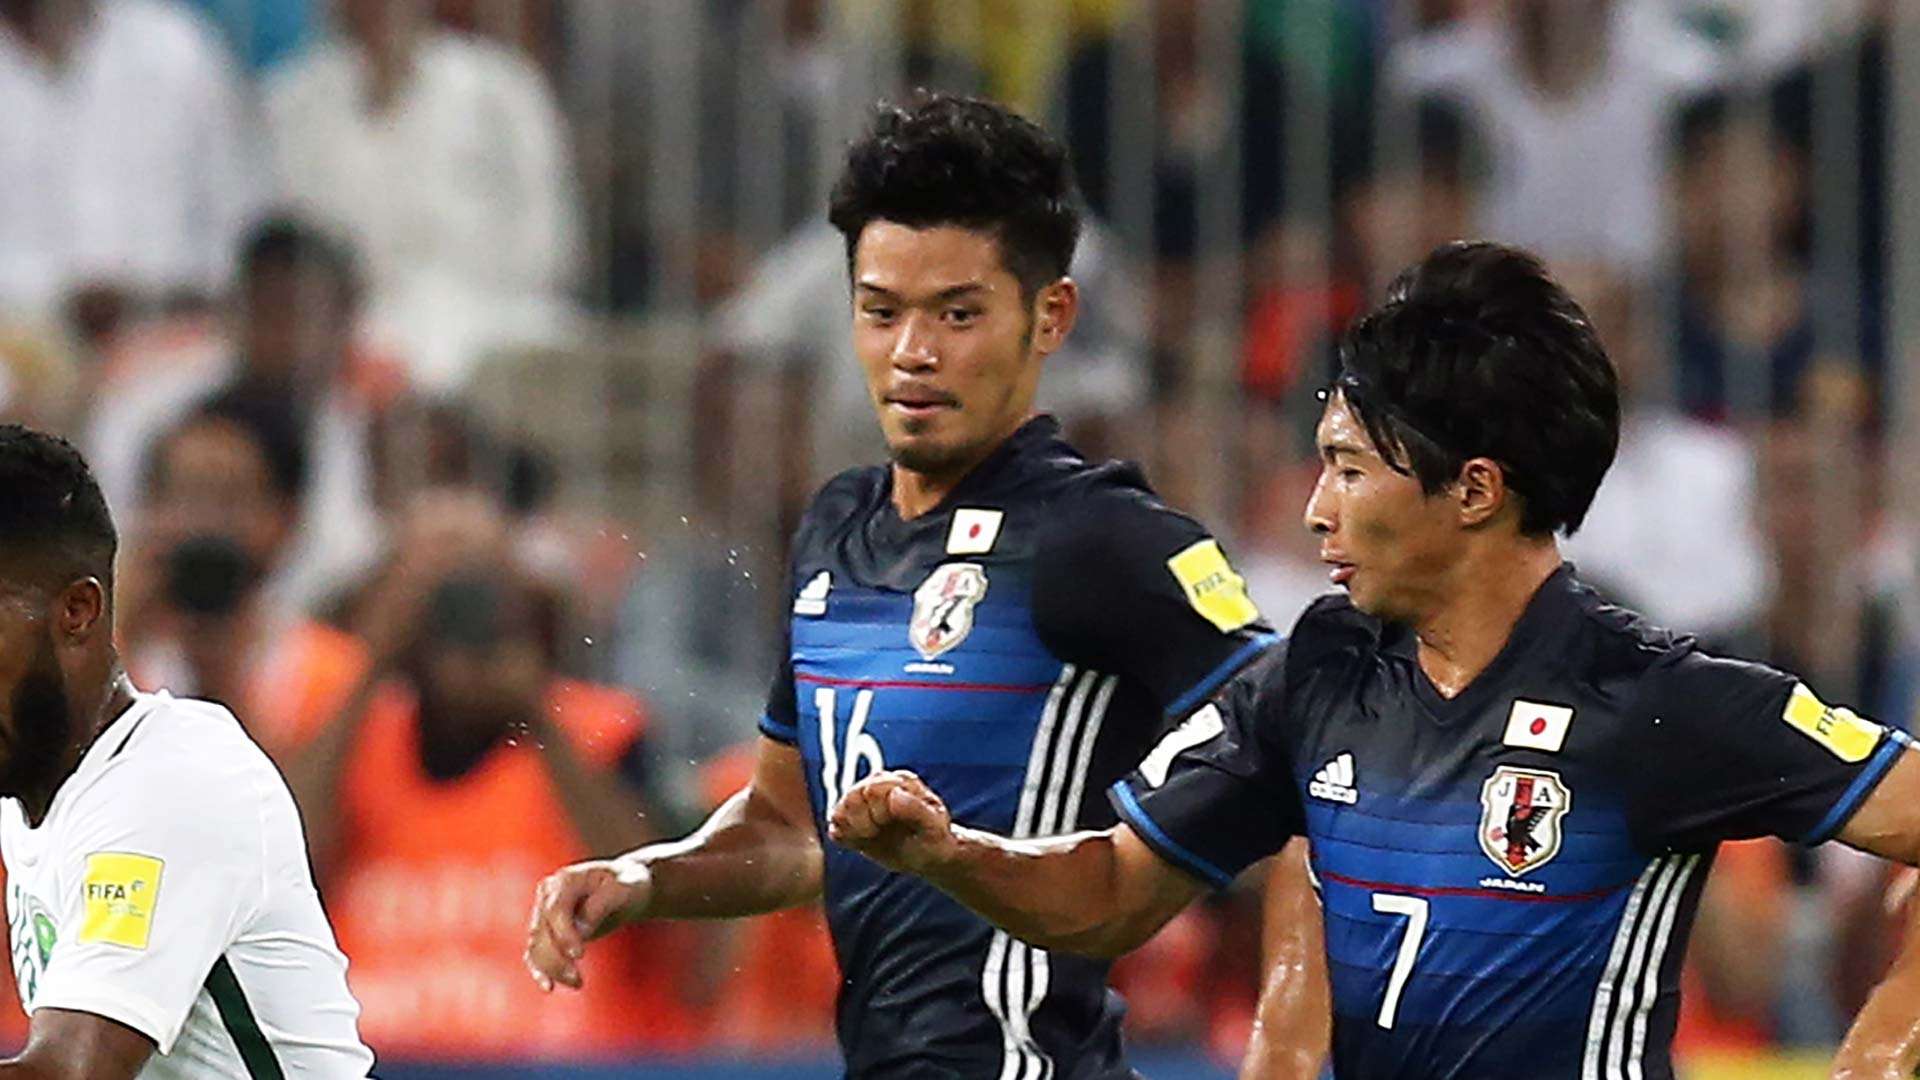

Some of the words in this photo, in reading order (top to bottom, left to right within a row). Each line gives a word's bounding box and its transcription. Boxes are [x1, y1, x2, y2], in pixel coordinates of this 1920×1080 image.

[1816, 707, 1837, 736] FIF
[815, 687, 884, 821] 16
[88, 884, 126, 900] FIFA
[1479, 877, 1546, 893] JAPAN
[1372, 893, 1428, 1029] 7
